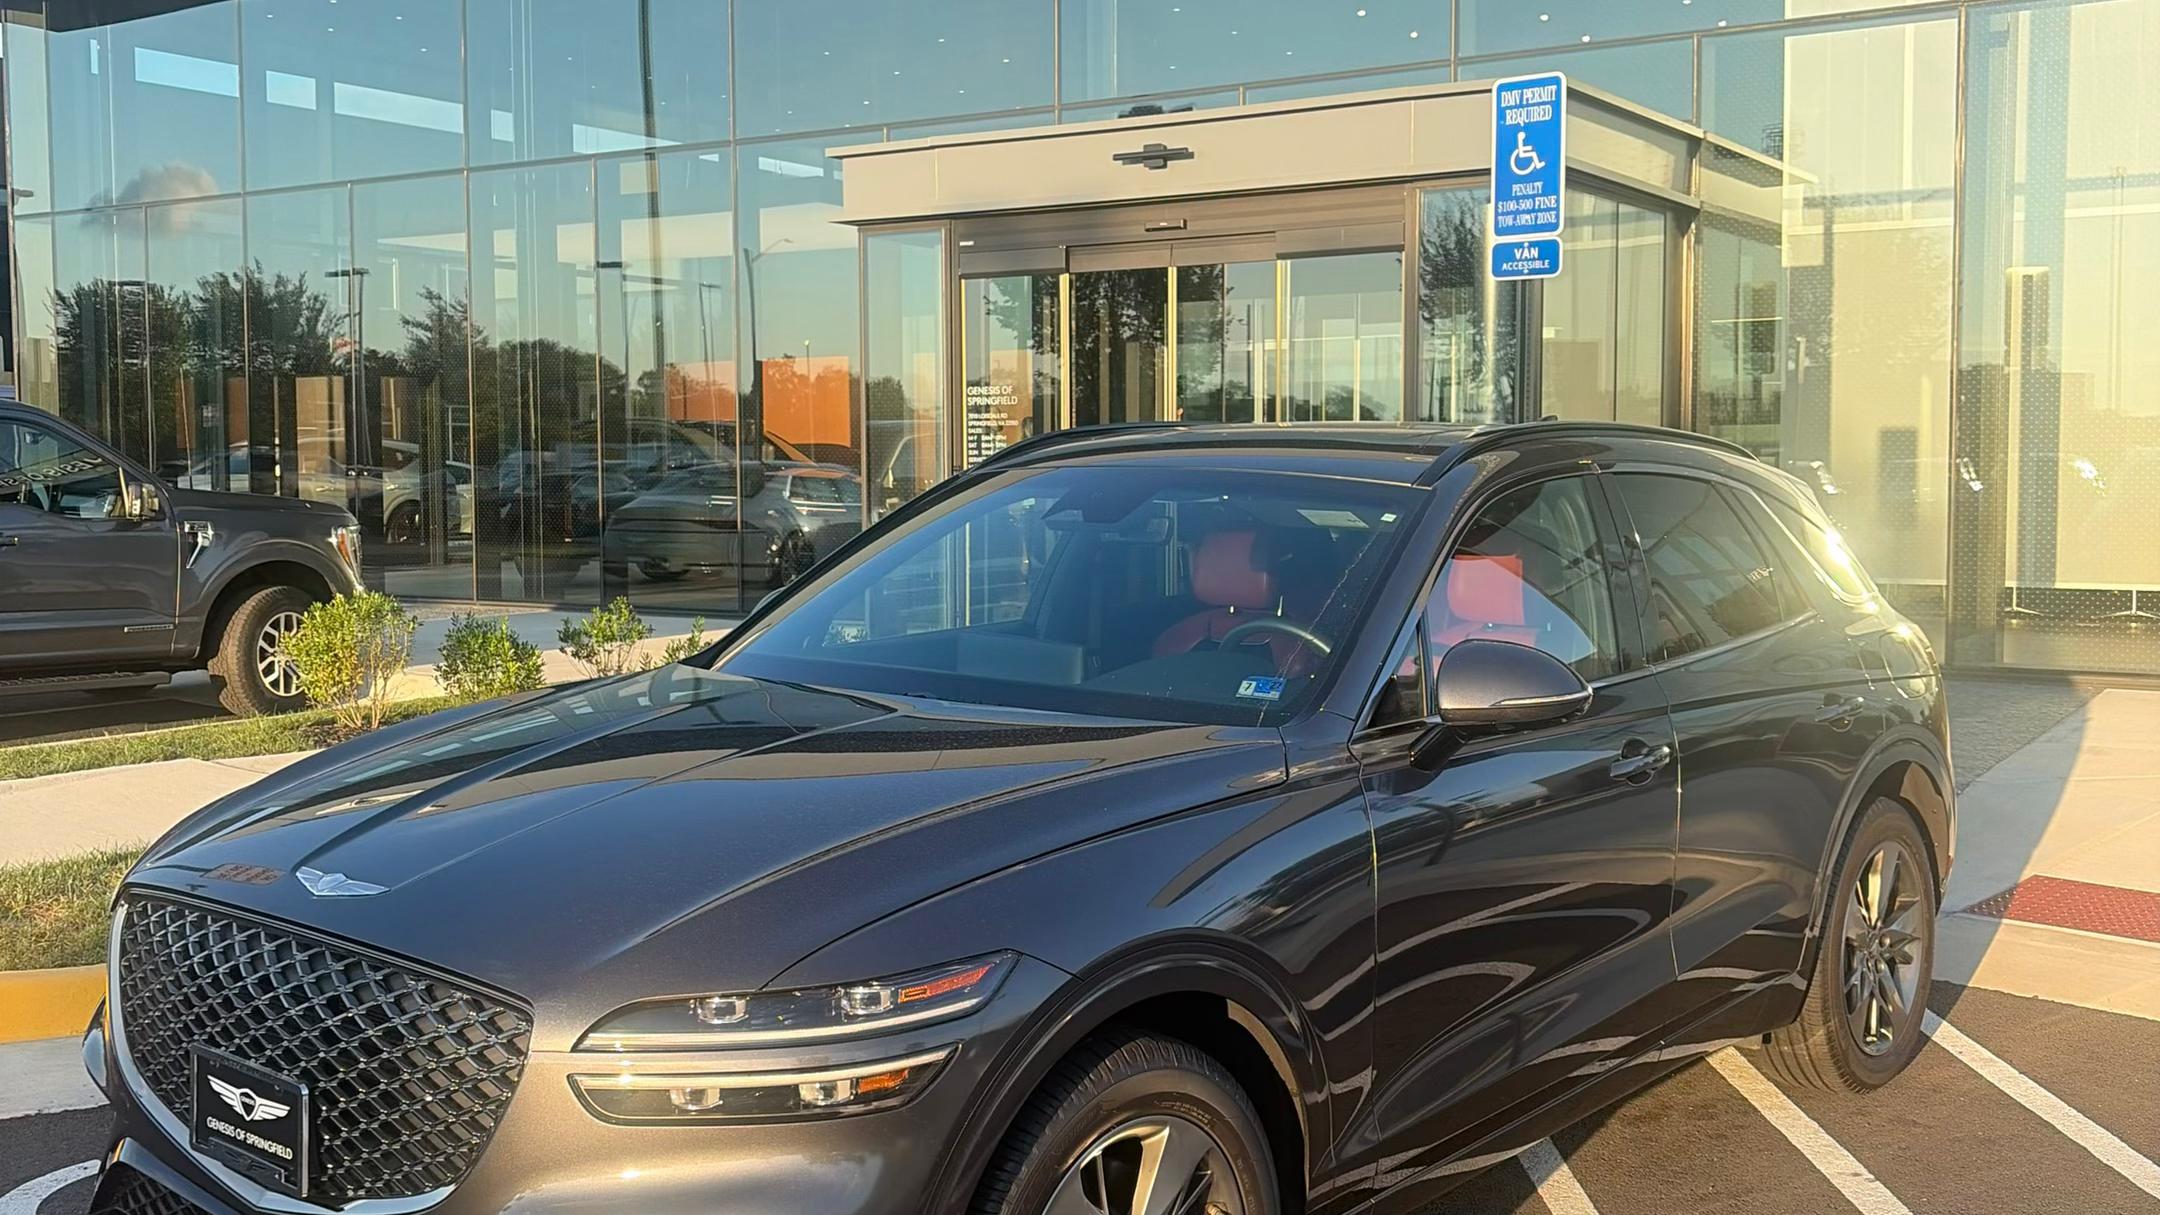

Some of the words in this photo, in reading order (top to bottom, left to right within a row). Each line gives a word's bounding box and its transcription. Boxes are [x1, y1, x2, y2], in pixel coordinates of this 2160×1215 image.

[1501, 90, 1521, 107] DMV
[1522, 85, 1557, 104] PERMIT
[1505, 104, 1552, 125] REQUIRED
[1512, 181, 1544, 196] PENALTY
[1497, 198, 1533, 213] $100-500
[1534, 195, 1557, 209] FINE
[1497, 212, 1536, 228] TOW-AWAY
[1536, 211, 1557, 225] ZONE
[1514, 247, 1539, 260] VAN
[1502, 259, 1550, 271] ACCESSIBLE
[967, 386, 1000, 395] GENESIS
[1001, 385, 1014, 395] OF
[967, 396, 1018, 406] SPRINGFIELD
[1244, 682, 1253, 691] 7
[206, 1116, 235, 1138] GENESIS
[235, 1128, 246, 1141] OF
[246, 1132, 293, 1160] SPRINGFIELD
